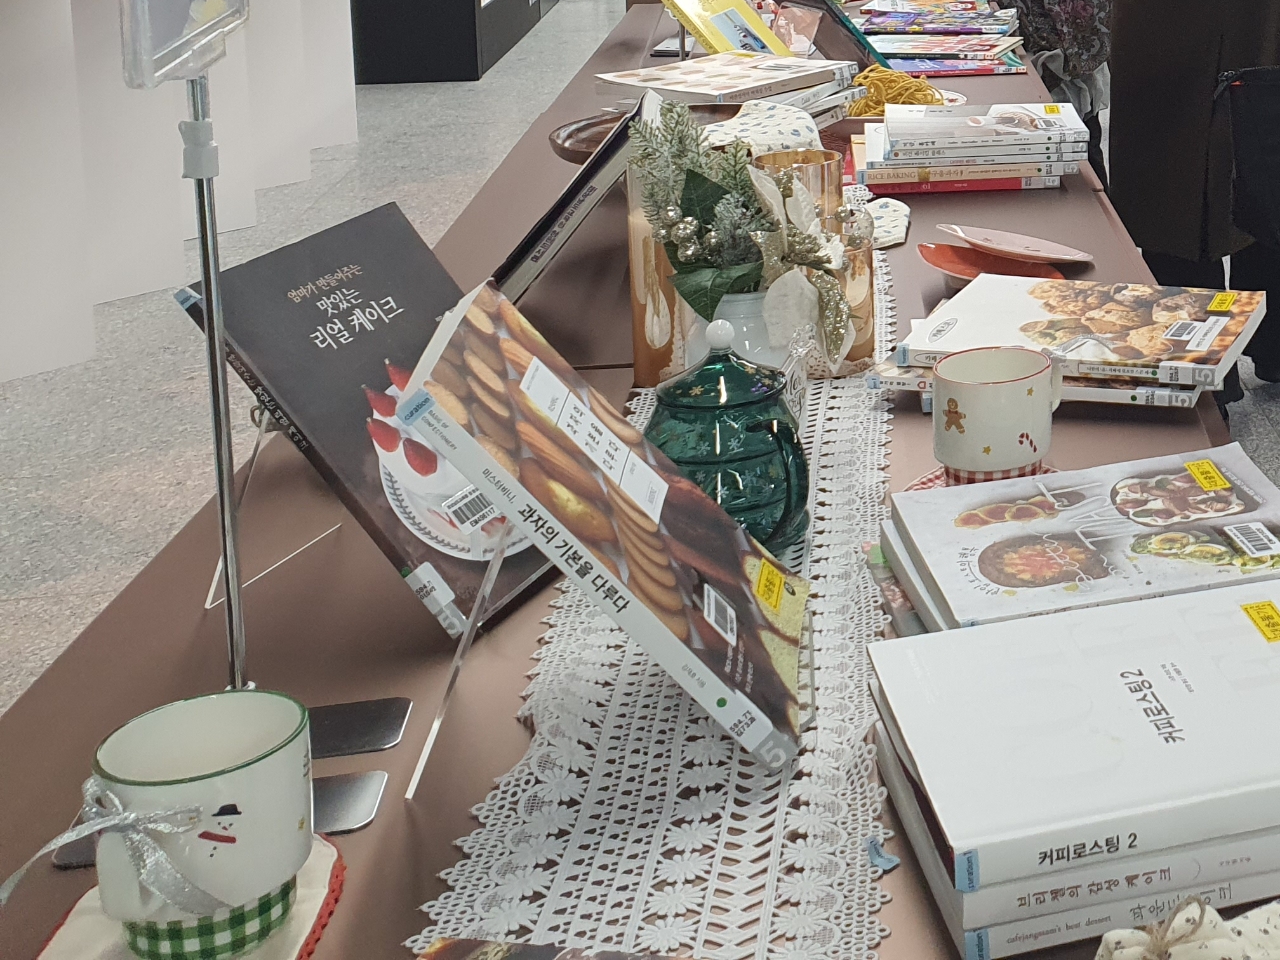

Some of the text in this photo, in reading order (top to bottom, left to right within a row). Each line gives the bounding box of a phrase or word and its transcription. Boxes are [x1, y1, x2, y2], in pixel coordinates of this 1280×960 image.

[867, 172, 886, 180] RICE
[886, 171, 916, 179] BAKING
[287, 263, 363, 304] 엄마가 만들어주는
[316, 288, 364, 318] 맛있는
[309, 296, 405, 350] 리얼 케이크
[1196, 368, 1214, 382] 5
[254, 386, 277, 410] 맛있는
[288, 425, 309, 451] 케이크
[403, 396, 430, 422] curation
[427, 409, 443, 427] BASIC
[420, 415, 458, 451] CONFECTIONERY
[1036, 481, 1138, 551] TOAST
[516, 502, 560, 543] 과자의
[555, 538, 595, 580] 기본을
[590, 573, 631, 614] 다루다
[1119, 667, 1145, 680] 2
[1123, 679, 1186, 745] 커피로스팅
[758, 738, 788, 770] 5
[1038, 832, 1138, 866] 커피로스팅 2
[1086, 878, 1120, 896] 감성
[1124, 867, 1172, 888] 케이크
[1065, 921, 1082, 932] best
[1085, 915, 1112, 928] dessert
